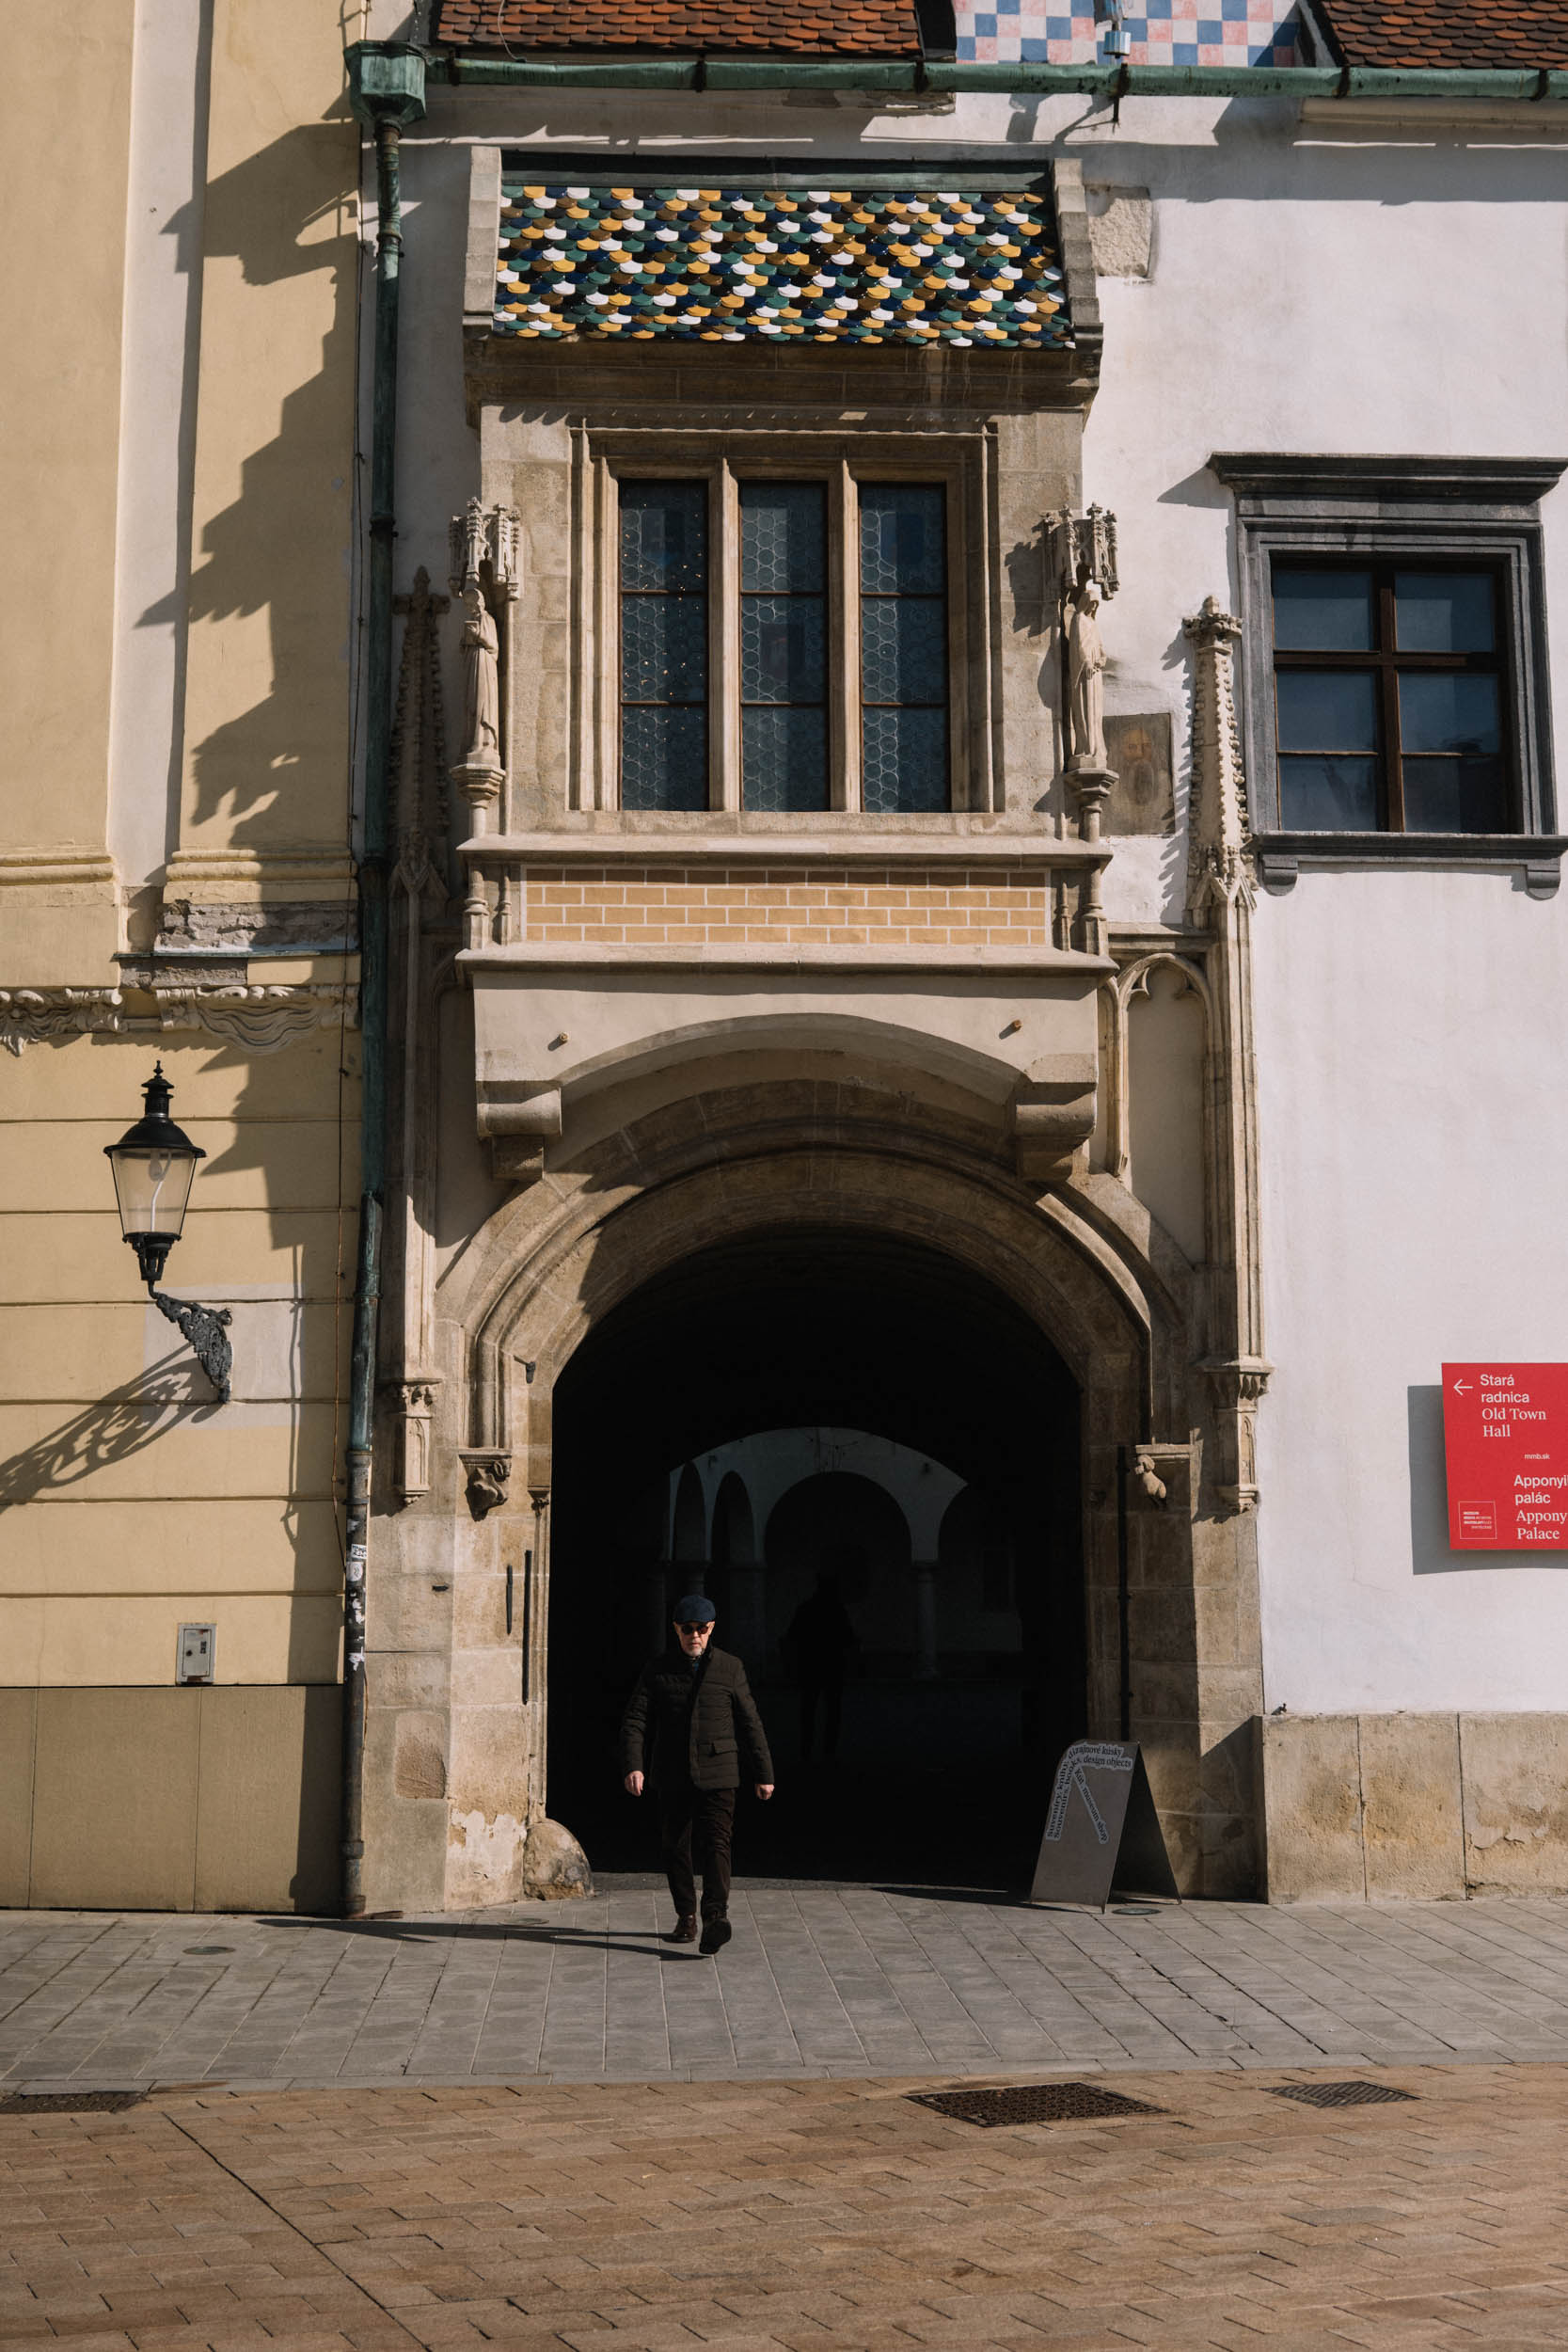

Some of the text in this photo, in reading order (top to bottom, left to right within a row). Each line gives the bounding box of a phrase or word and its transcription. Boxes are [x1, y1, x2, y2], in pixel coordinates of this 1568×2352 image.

[1480, 1374, 1514, 1386] Stará
[1481, 1391, 1530, 1403] radnica
[1481, 1407, 1546, 1421] Old Town
[1483, 1425, 1511, 1438] Hall
[1513, 1474, 1568, 1488] Apponyi
[1515, 1492, 1551, 1505] palác
[1517, 1527, 1560, 1539] Palace
[1083, 1754, 1105, 1767] design
[1097, 1820, 1109, 1842] shop
